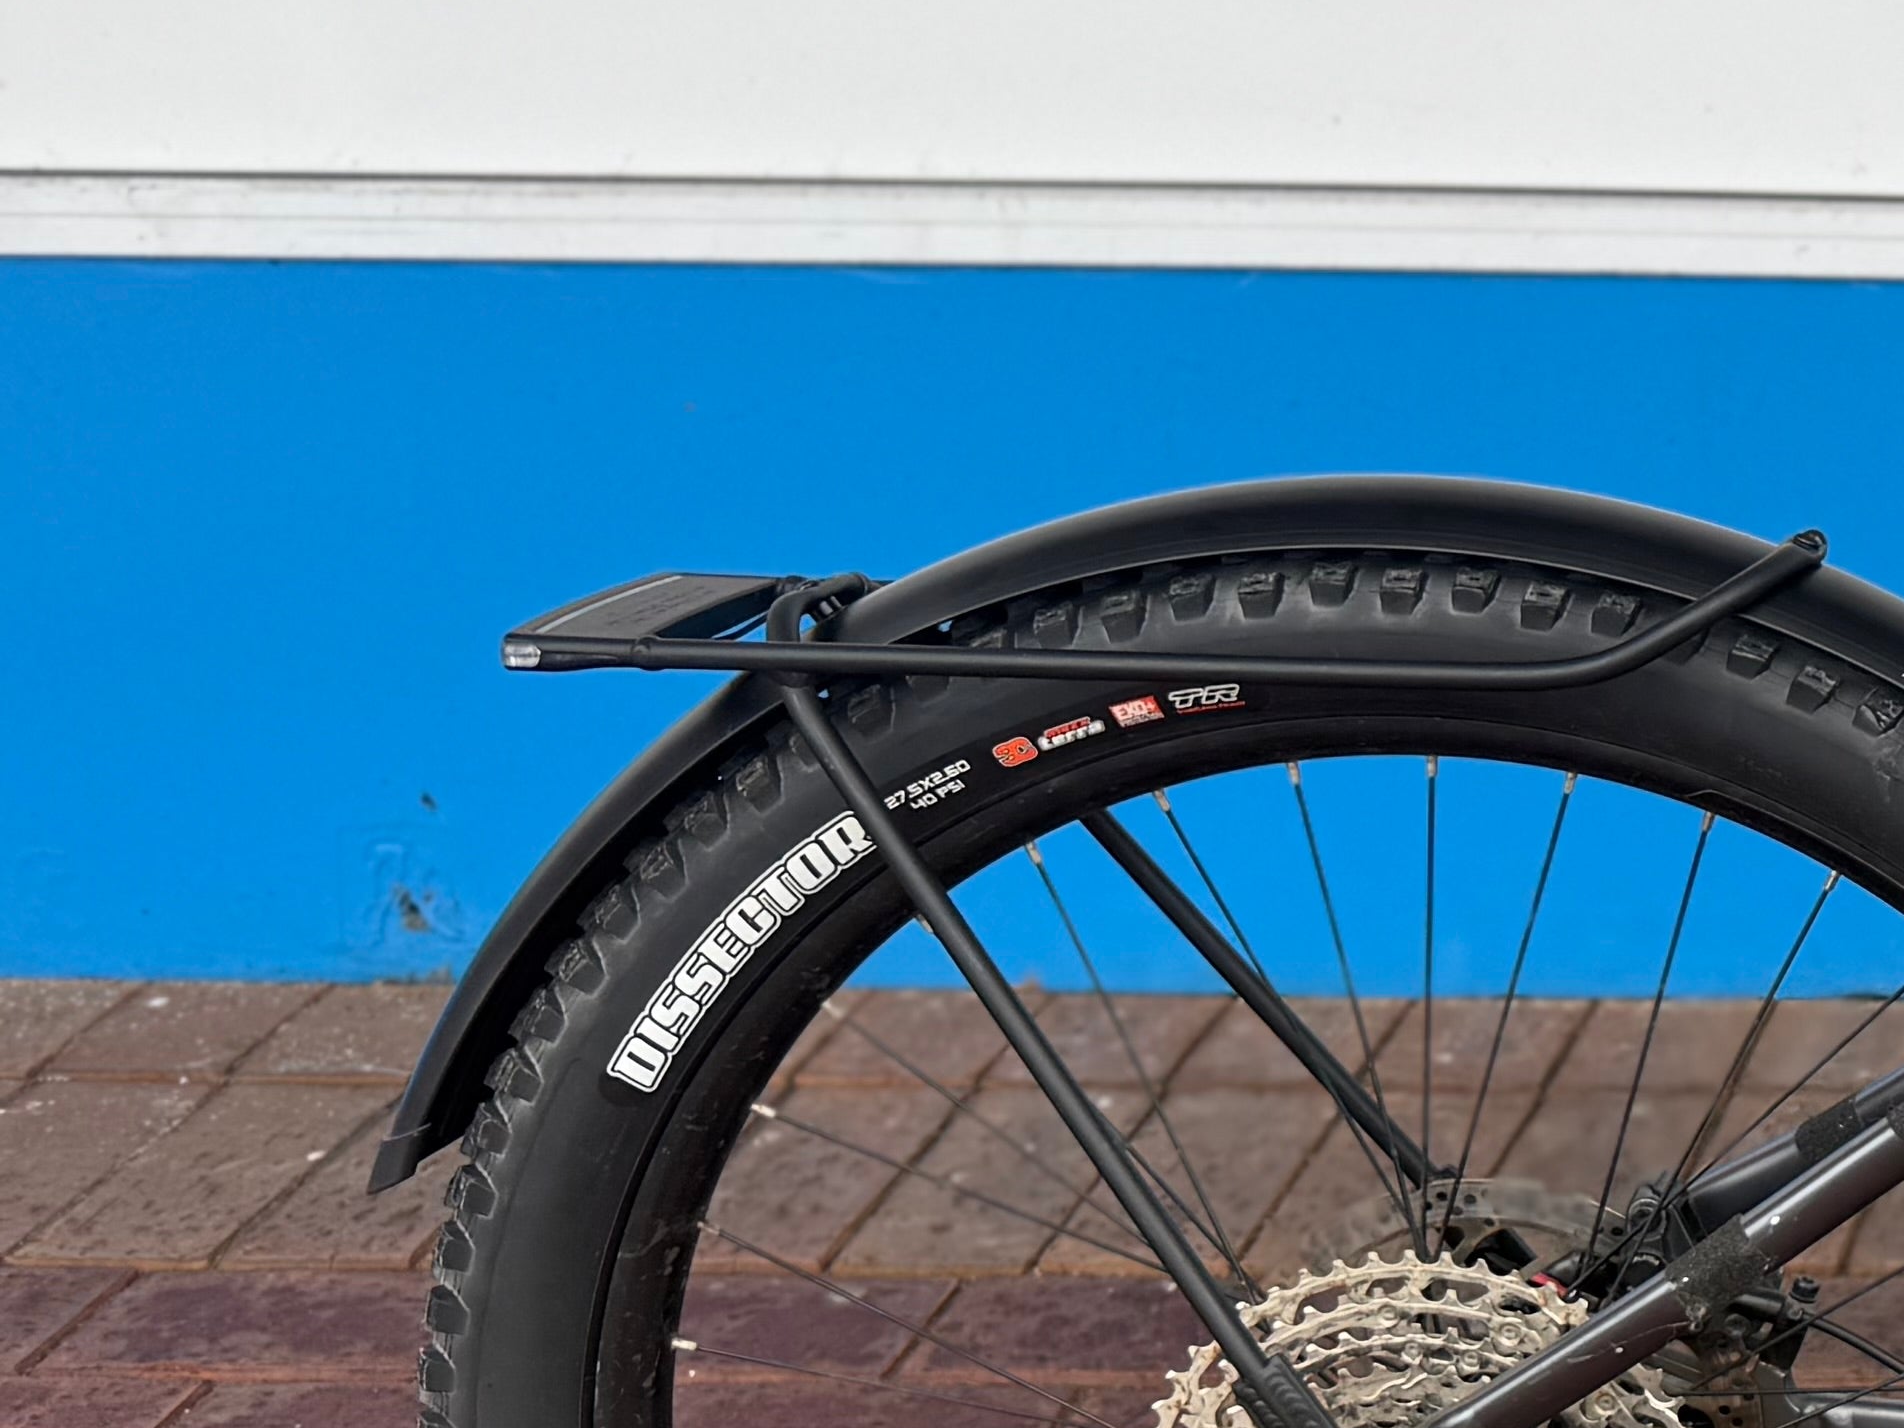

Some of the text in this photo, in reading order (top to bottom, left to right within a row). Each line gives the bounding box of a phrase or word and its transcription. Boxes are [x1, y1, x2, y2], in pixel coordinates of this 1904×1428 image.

[1168, 683, 1240, 710] TR
[909, 779, 966, 811] 40 PSI
[606, 811, 877, 1093] DISSECTOR
